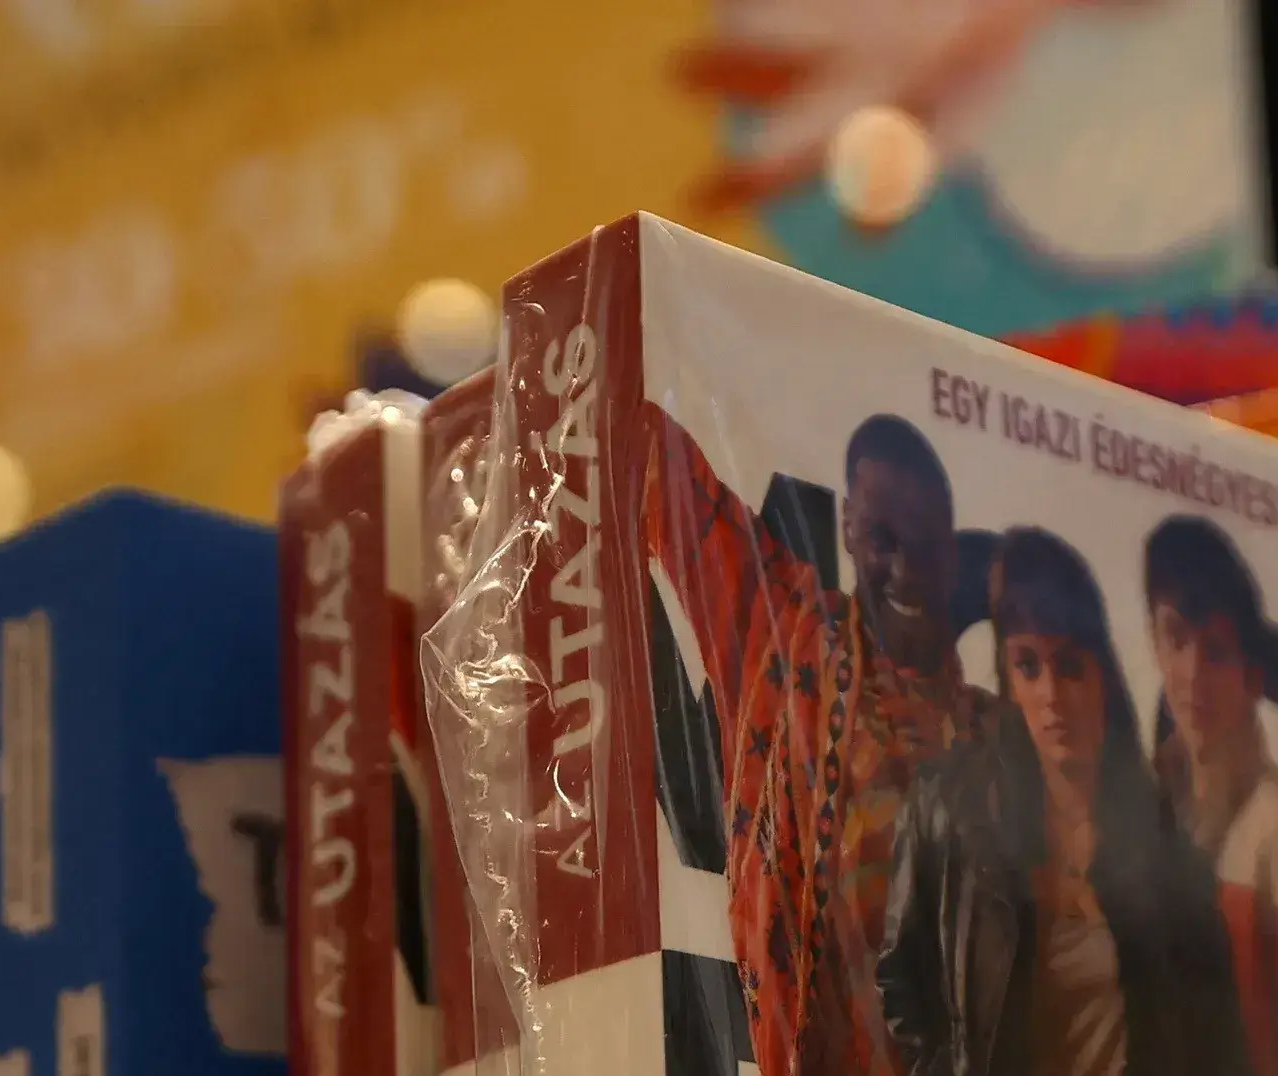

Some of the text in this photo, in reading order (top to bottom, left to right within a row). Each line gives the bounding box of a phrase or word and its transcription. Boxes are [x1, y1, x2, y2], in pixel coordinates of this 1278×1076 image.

[930, 367, 991, 431] EGY
[1000, 391, 1082, 463] IGAZI
[296, 520, 358, 906] UTAZÁS
